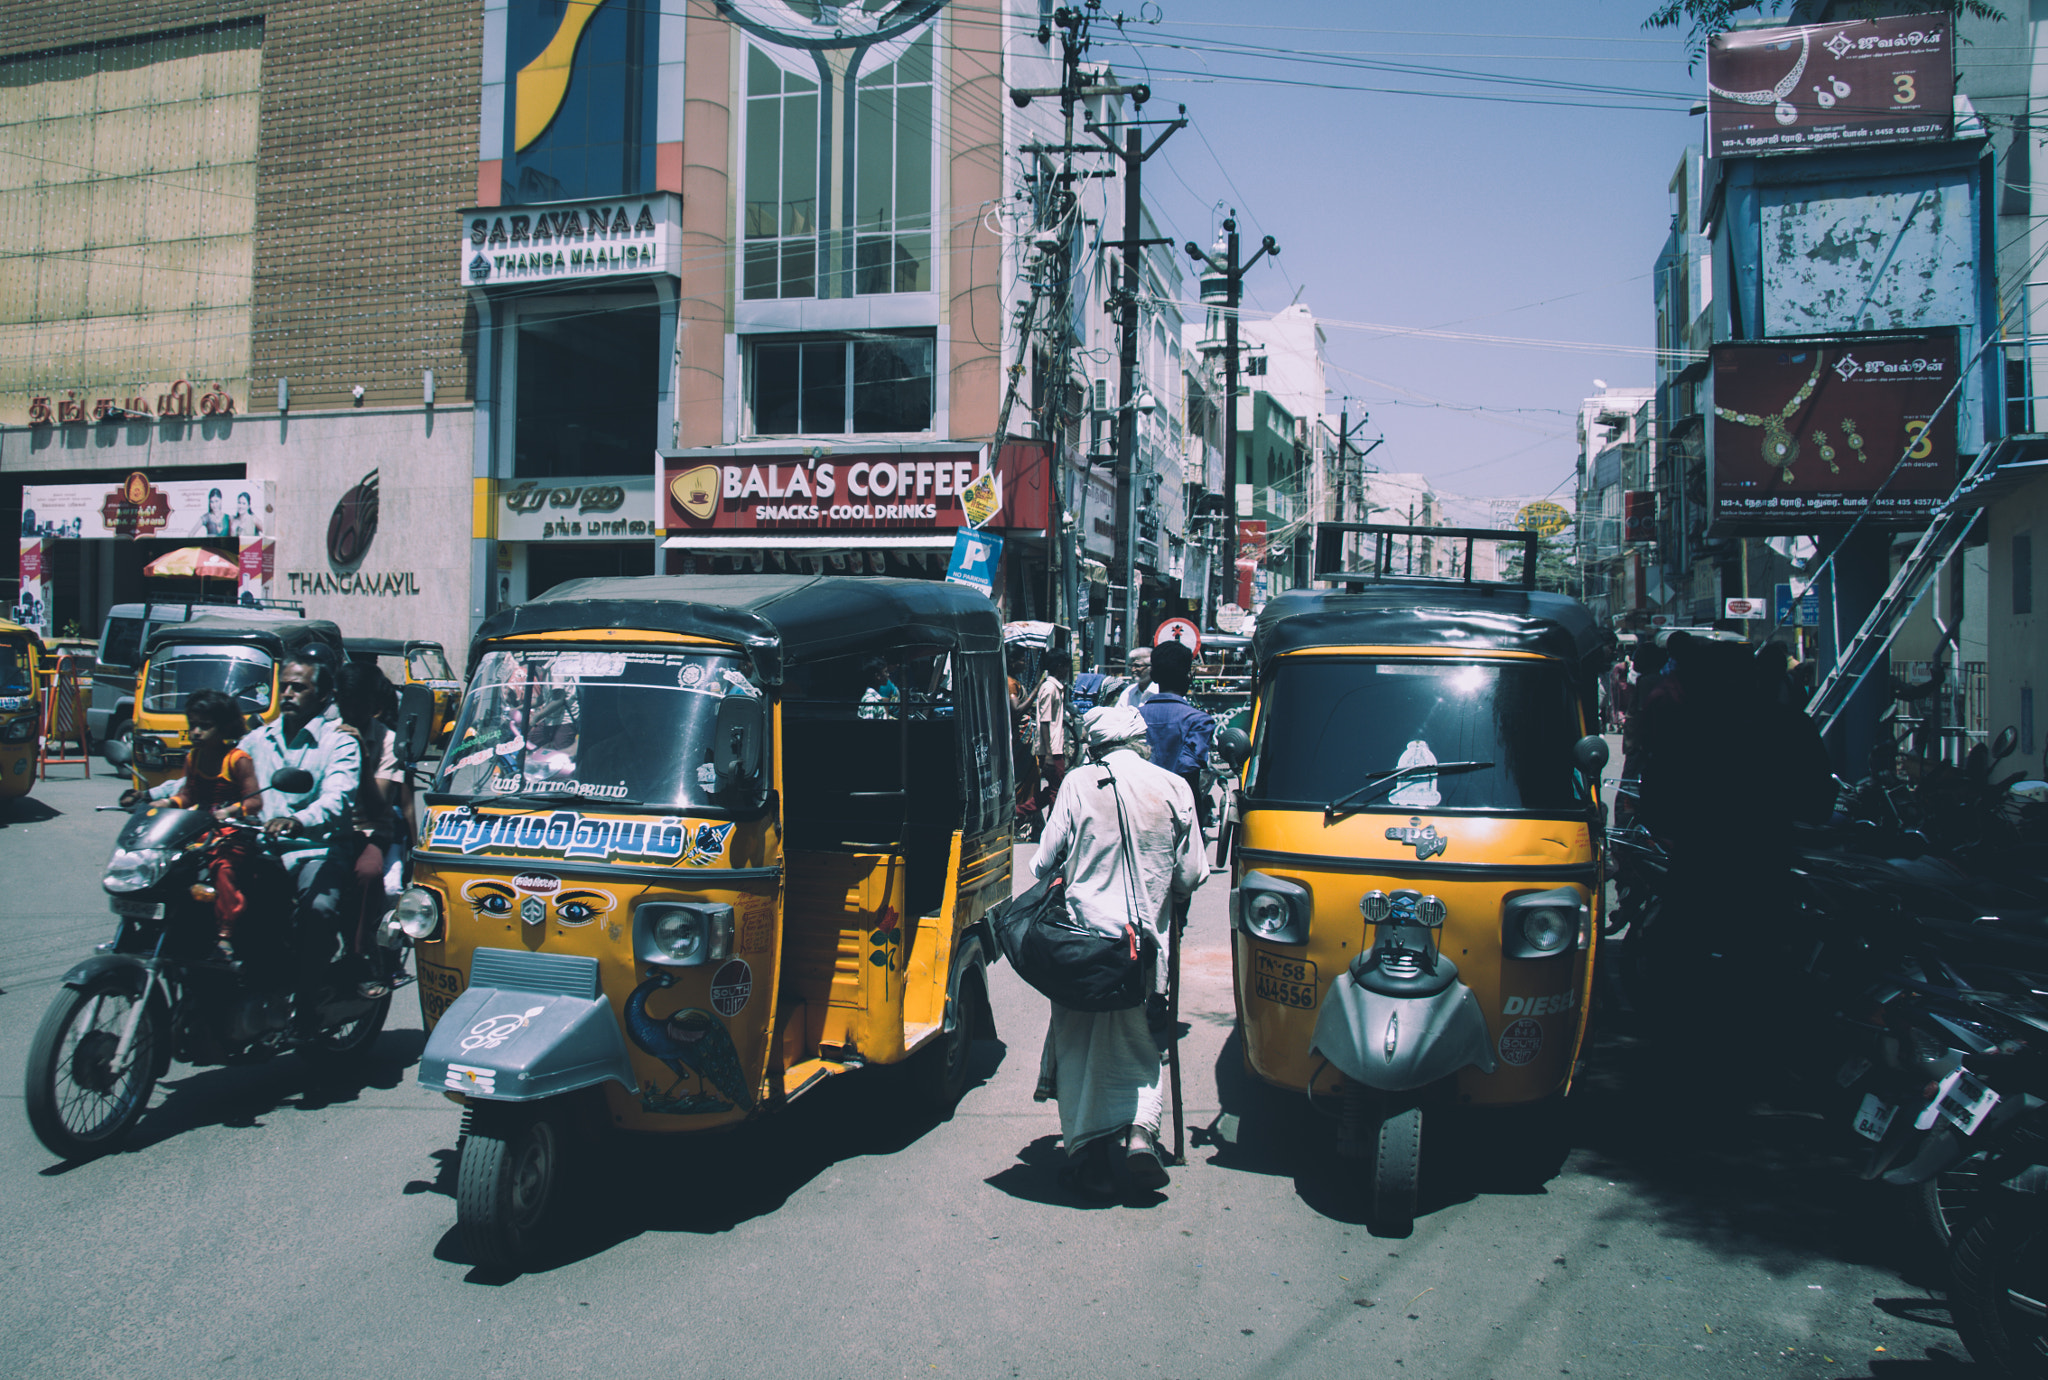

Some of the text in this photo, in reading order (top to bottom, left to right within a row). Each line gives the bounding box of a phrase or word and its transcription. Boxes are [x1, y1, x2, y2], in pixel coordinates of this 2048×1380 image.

[1893, 74, 1916, 104] 3
[471, 203, 656, 244] SARAVANAA
[493, 242, 657, 270] THANGA MAALIGAI
[28, 379, 234, 428] தங்கமயில்
[1904, 420, 1933, 459] 3
[723, 458, 974, 499] BALA'S COFFEE
[755, 505, 819, 520] SNACKS
[829, 505, 873, 520] COOL
[874, 504, 937, 519] DRINKS
[543, 516, 582, 538] தங்க
[959, 540, 992, 571] P
[288, 571, 421, 597] THANGAMAYIL
[952, 571, 989, 585] NO PARKING
[1387, 826, 1434, 844] ape
[712, 985, 750, 998] SOUTH
[1502, 987, 1576, 1017] DIESEL
[1502, 1038, 1540, 1049] SOUTH
